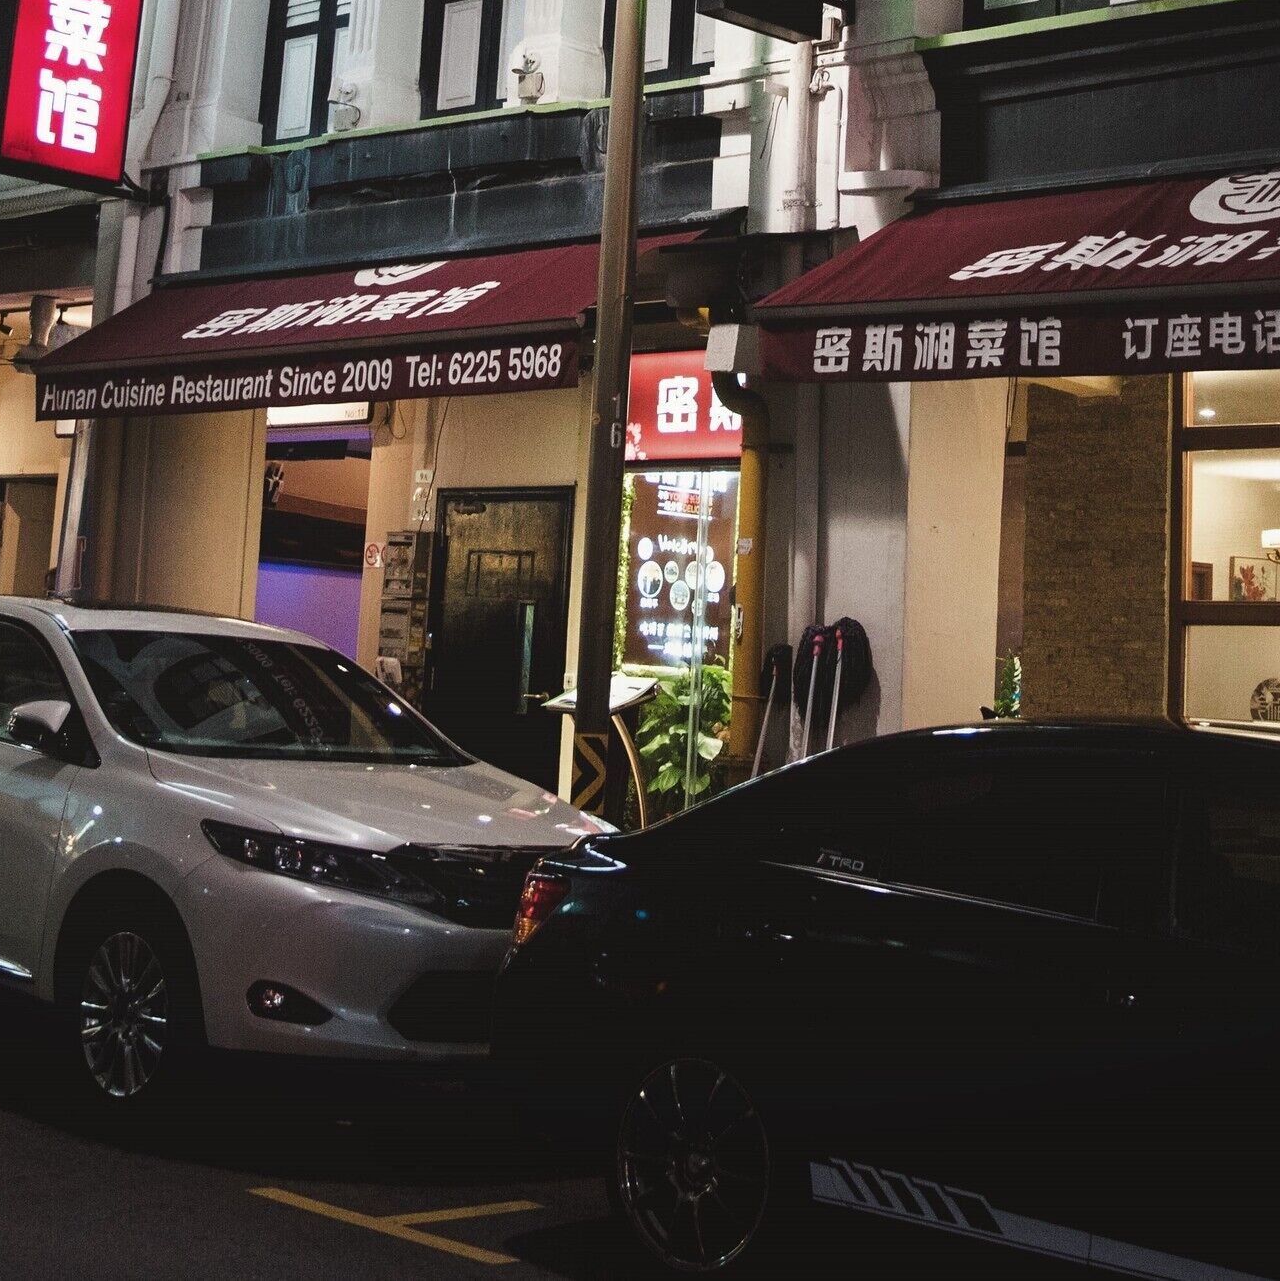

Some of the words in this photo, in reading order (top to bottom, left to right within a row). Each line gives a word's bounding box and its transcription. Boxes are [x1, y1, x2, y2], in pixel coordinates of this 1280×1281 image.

[182, 281, 501, 340] 密斯湘菜馆
[813, 317, 1062, 374] 密斯湘菜馆
[41, 383, 97, 411] Hunan
[100, 377, 166, 410] Cuisine
[170, 368, 274, 405] Restaurant
[279, 365, 336, 398] Since
[341, 358, 393, 393] 2009
[405, 353, 442, 388] Tel:
[448, 348, 502, 385] 6225
[507, 343, 562, 381] 5968
[829, 855, 864, 872] TRD
